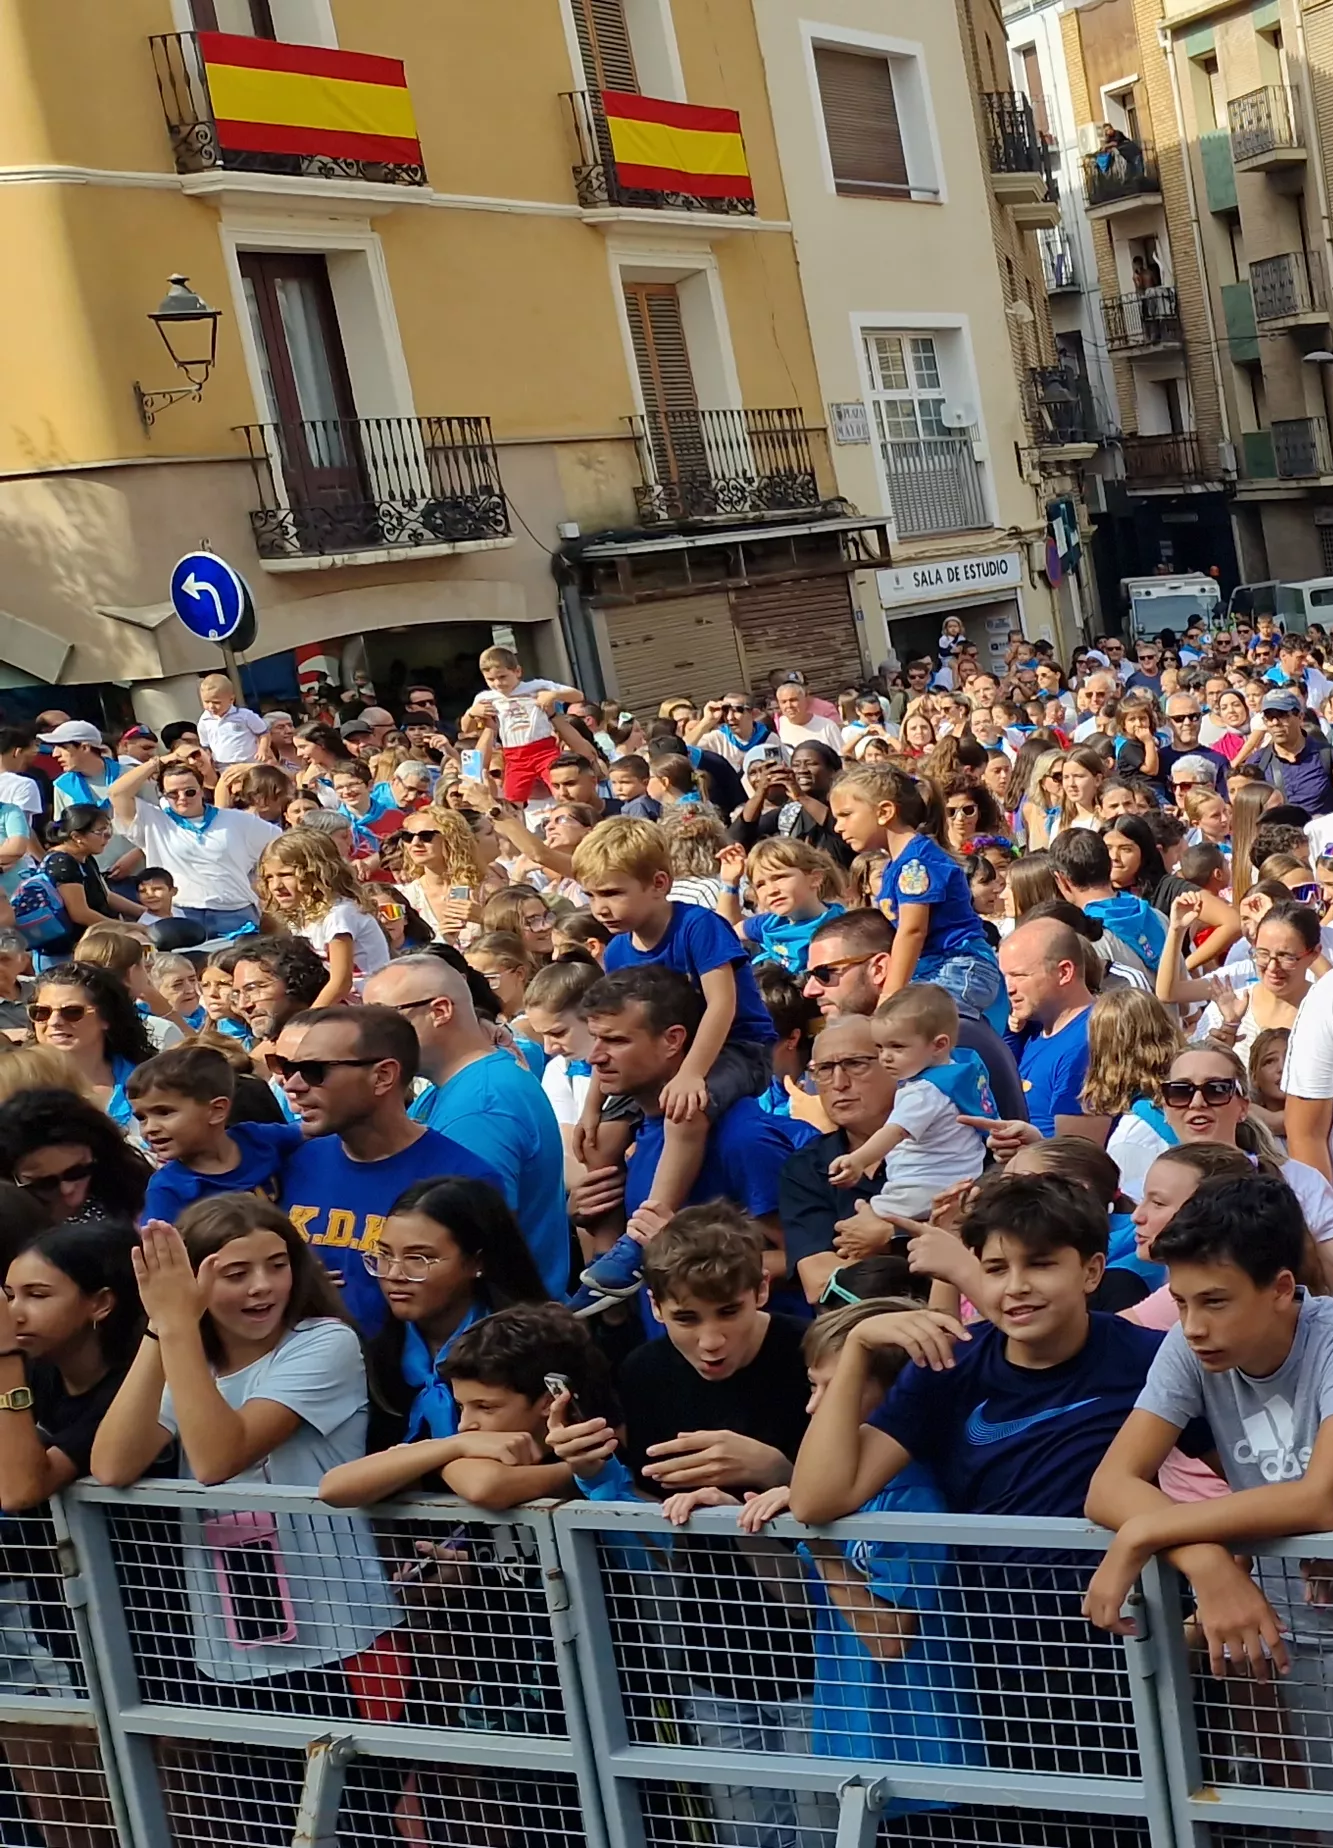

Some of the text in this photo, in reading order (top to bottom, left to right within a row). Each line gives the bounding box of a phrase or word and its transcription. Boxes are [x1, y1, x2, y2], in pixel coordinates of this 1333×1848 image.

[843, 407, 865, 419] PLAZA
[837, 423, 868, 437] MAYOR
[912, 559, 1009, 588] SALA DE ESTUDIO
